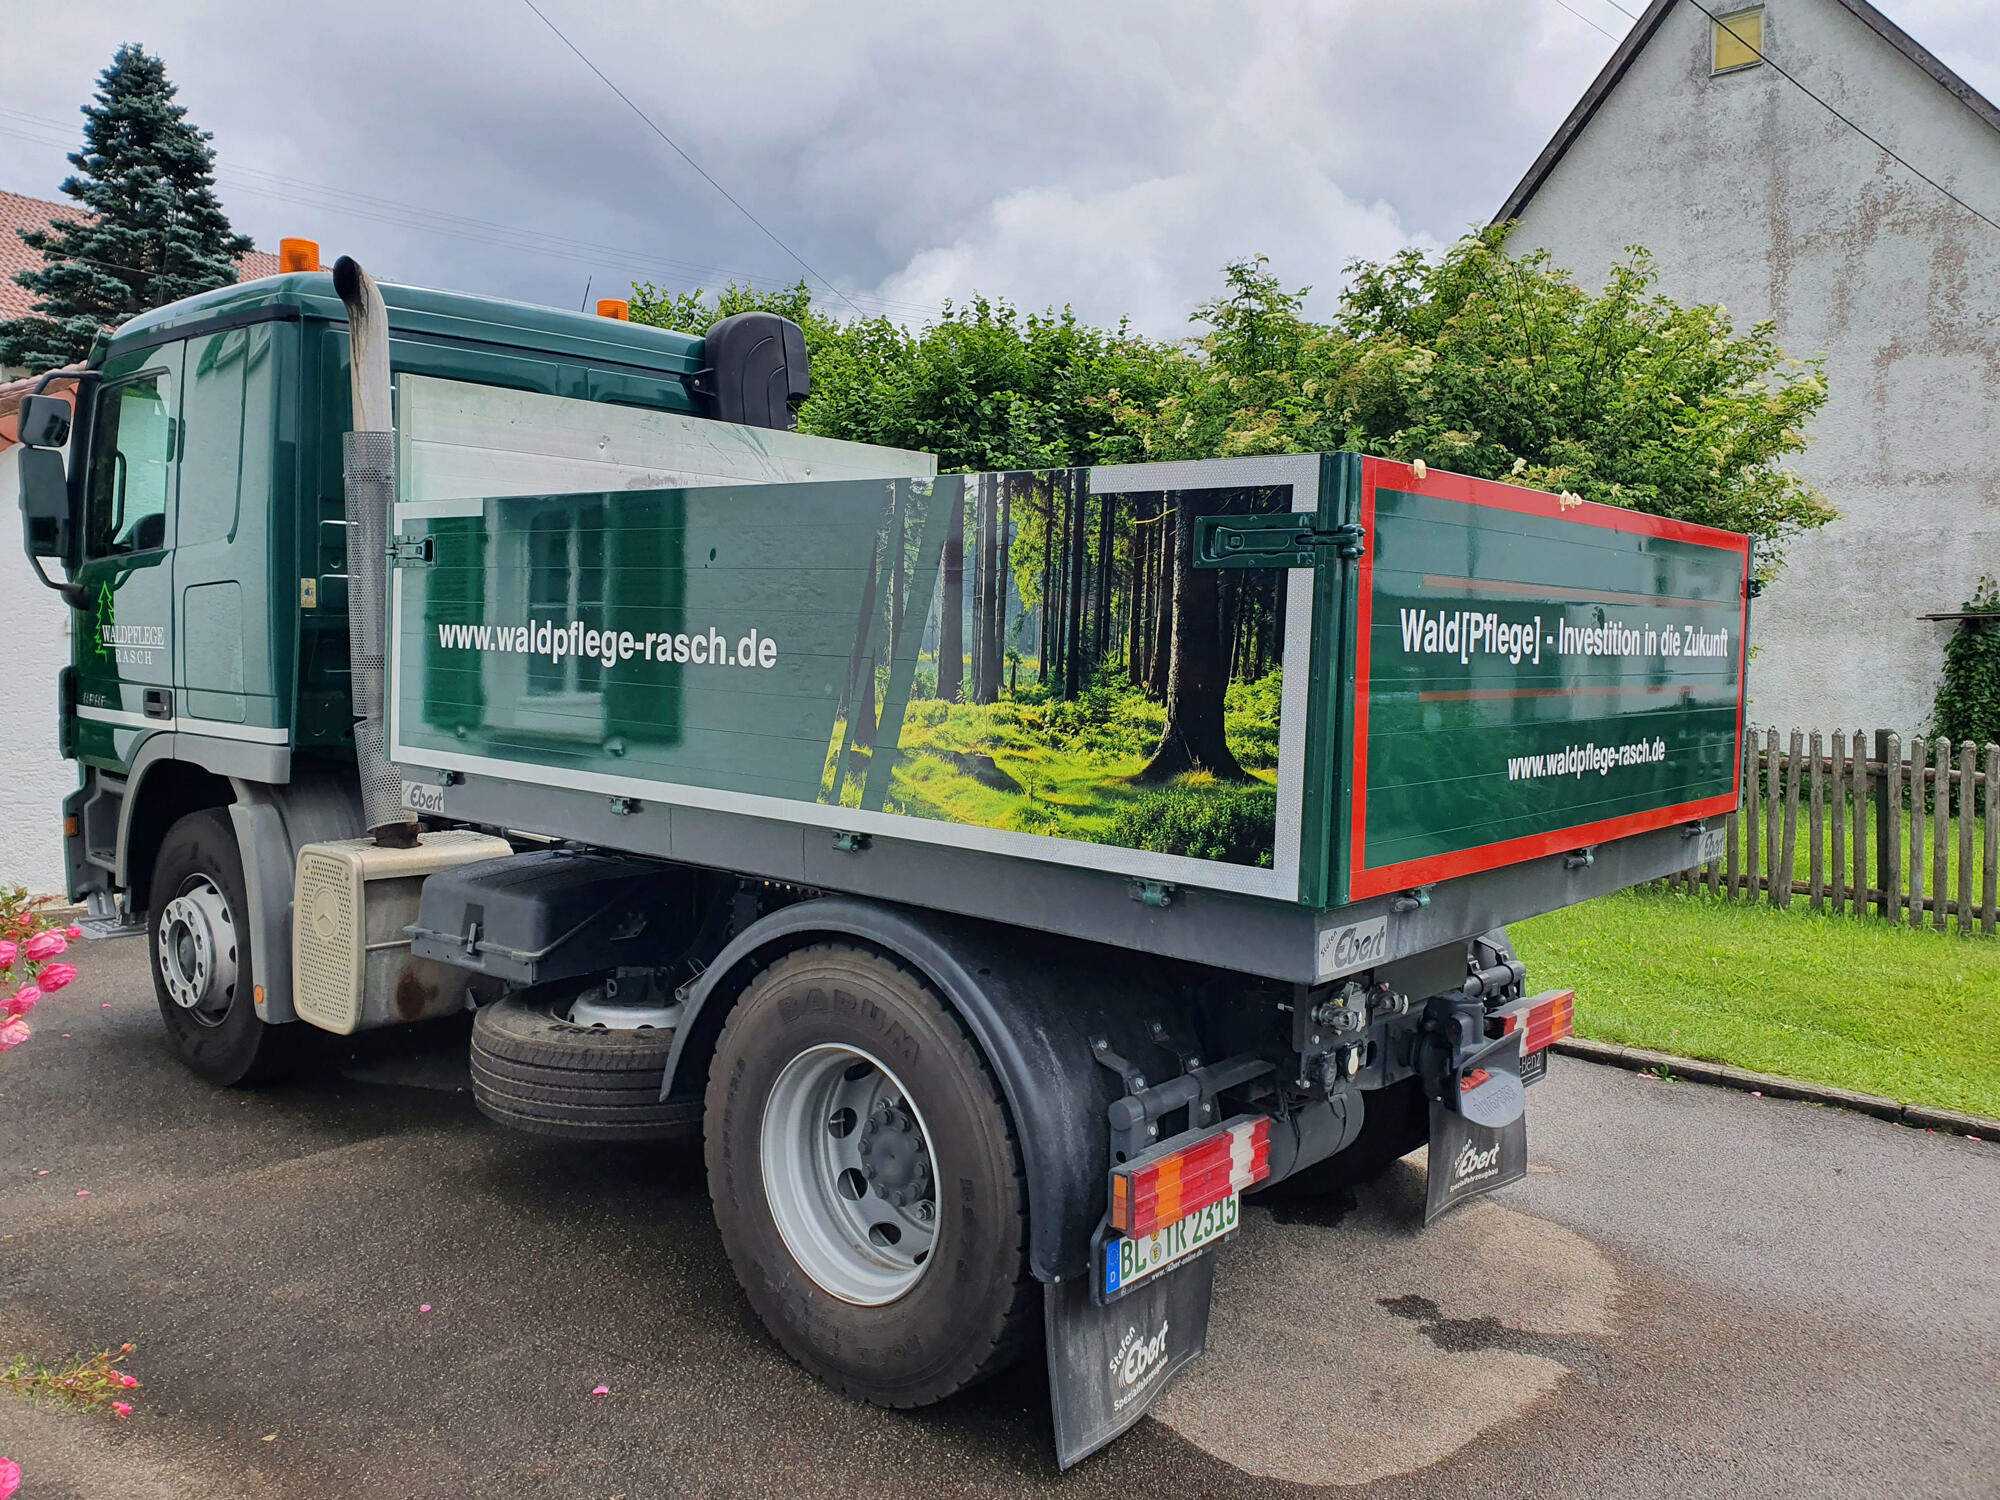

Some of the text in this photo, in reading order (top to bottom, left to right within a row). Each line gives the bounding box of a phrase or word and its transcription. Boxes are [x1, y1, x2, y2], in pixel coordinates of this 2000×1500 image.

[102, 624, 165, 646] WALDPFLEGE
[115, 648, 153, 665] RASCH
[438, 619, 778, 669] www.waldpflege-rasch.de
[1400, 607, 1541, 664] Wald[Pflege]
[1558, 617, 1640, 657] Investition
[1644, 622, 1656, 656] in
[1660, 624, 1681, 656] die
[1683, 624, 1729, 657] Zukunft
[1508, 735, 1666, 781] www.waldpflege-rasch.de
[410, 784, 443, 811] Ebert
[1334, 925, 1385, 969] Ebert
[1457, 1142, 1500, 1178] Ebert
[1121, 1198, 1237, 1280] BL TR 2315
[1110, 1271, 1117, 1283] D
[1109, 1326, 1136, 1375] Stefan
[1122, 1319, 1169, 1385] Ebert
